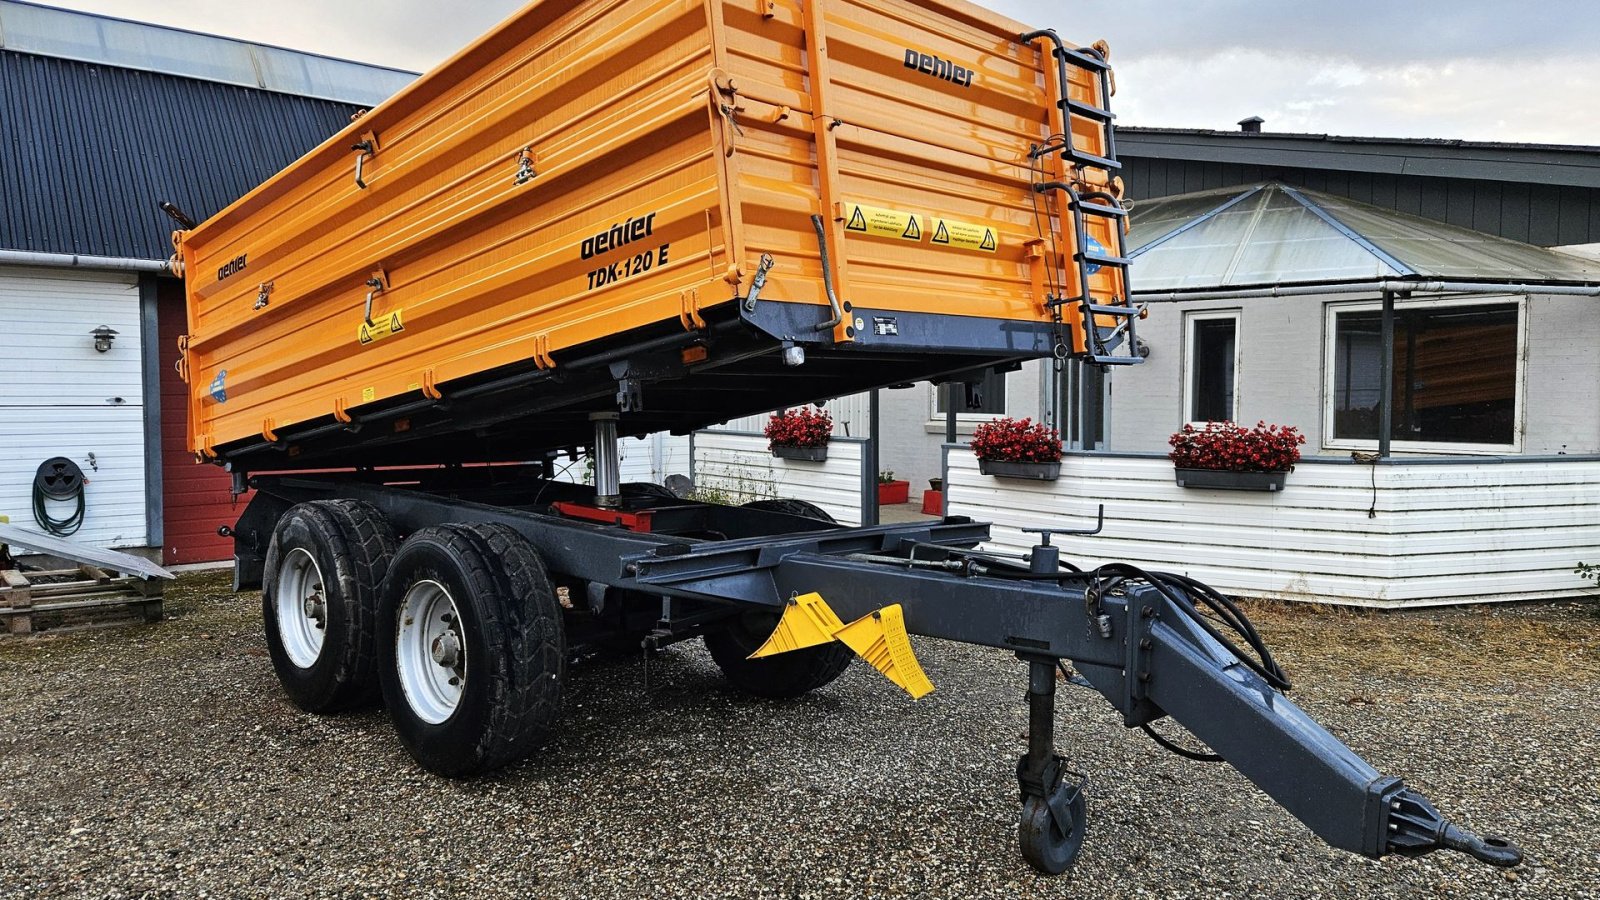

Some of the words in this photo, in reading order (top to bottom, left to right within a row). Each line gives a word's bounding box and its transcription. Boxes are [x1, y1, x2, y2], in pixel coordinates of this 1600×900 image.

[904, 48, 974, 88] oehler
[581, 212, 656, 260] oehler
[218, 253, 247, 281] oehler
[587, 250, 653, 290] TDK-120
[658, 243, 670, 266] E
